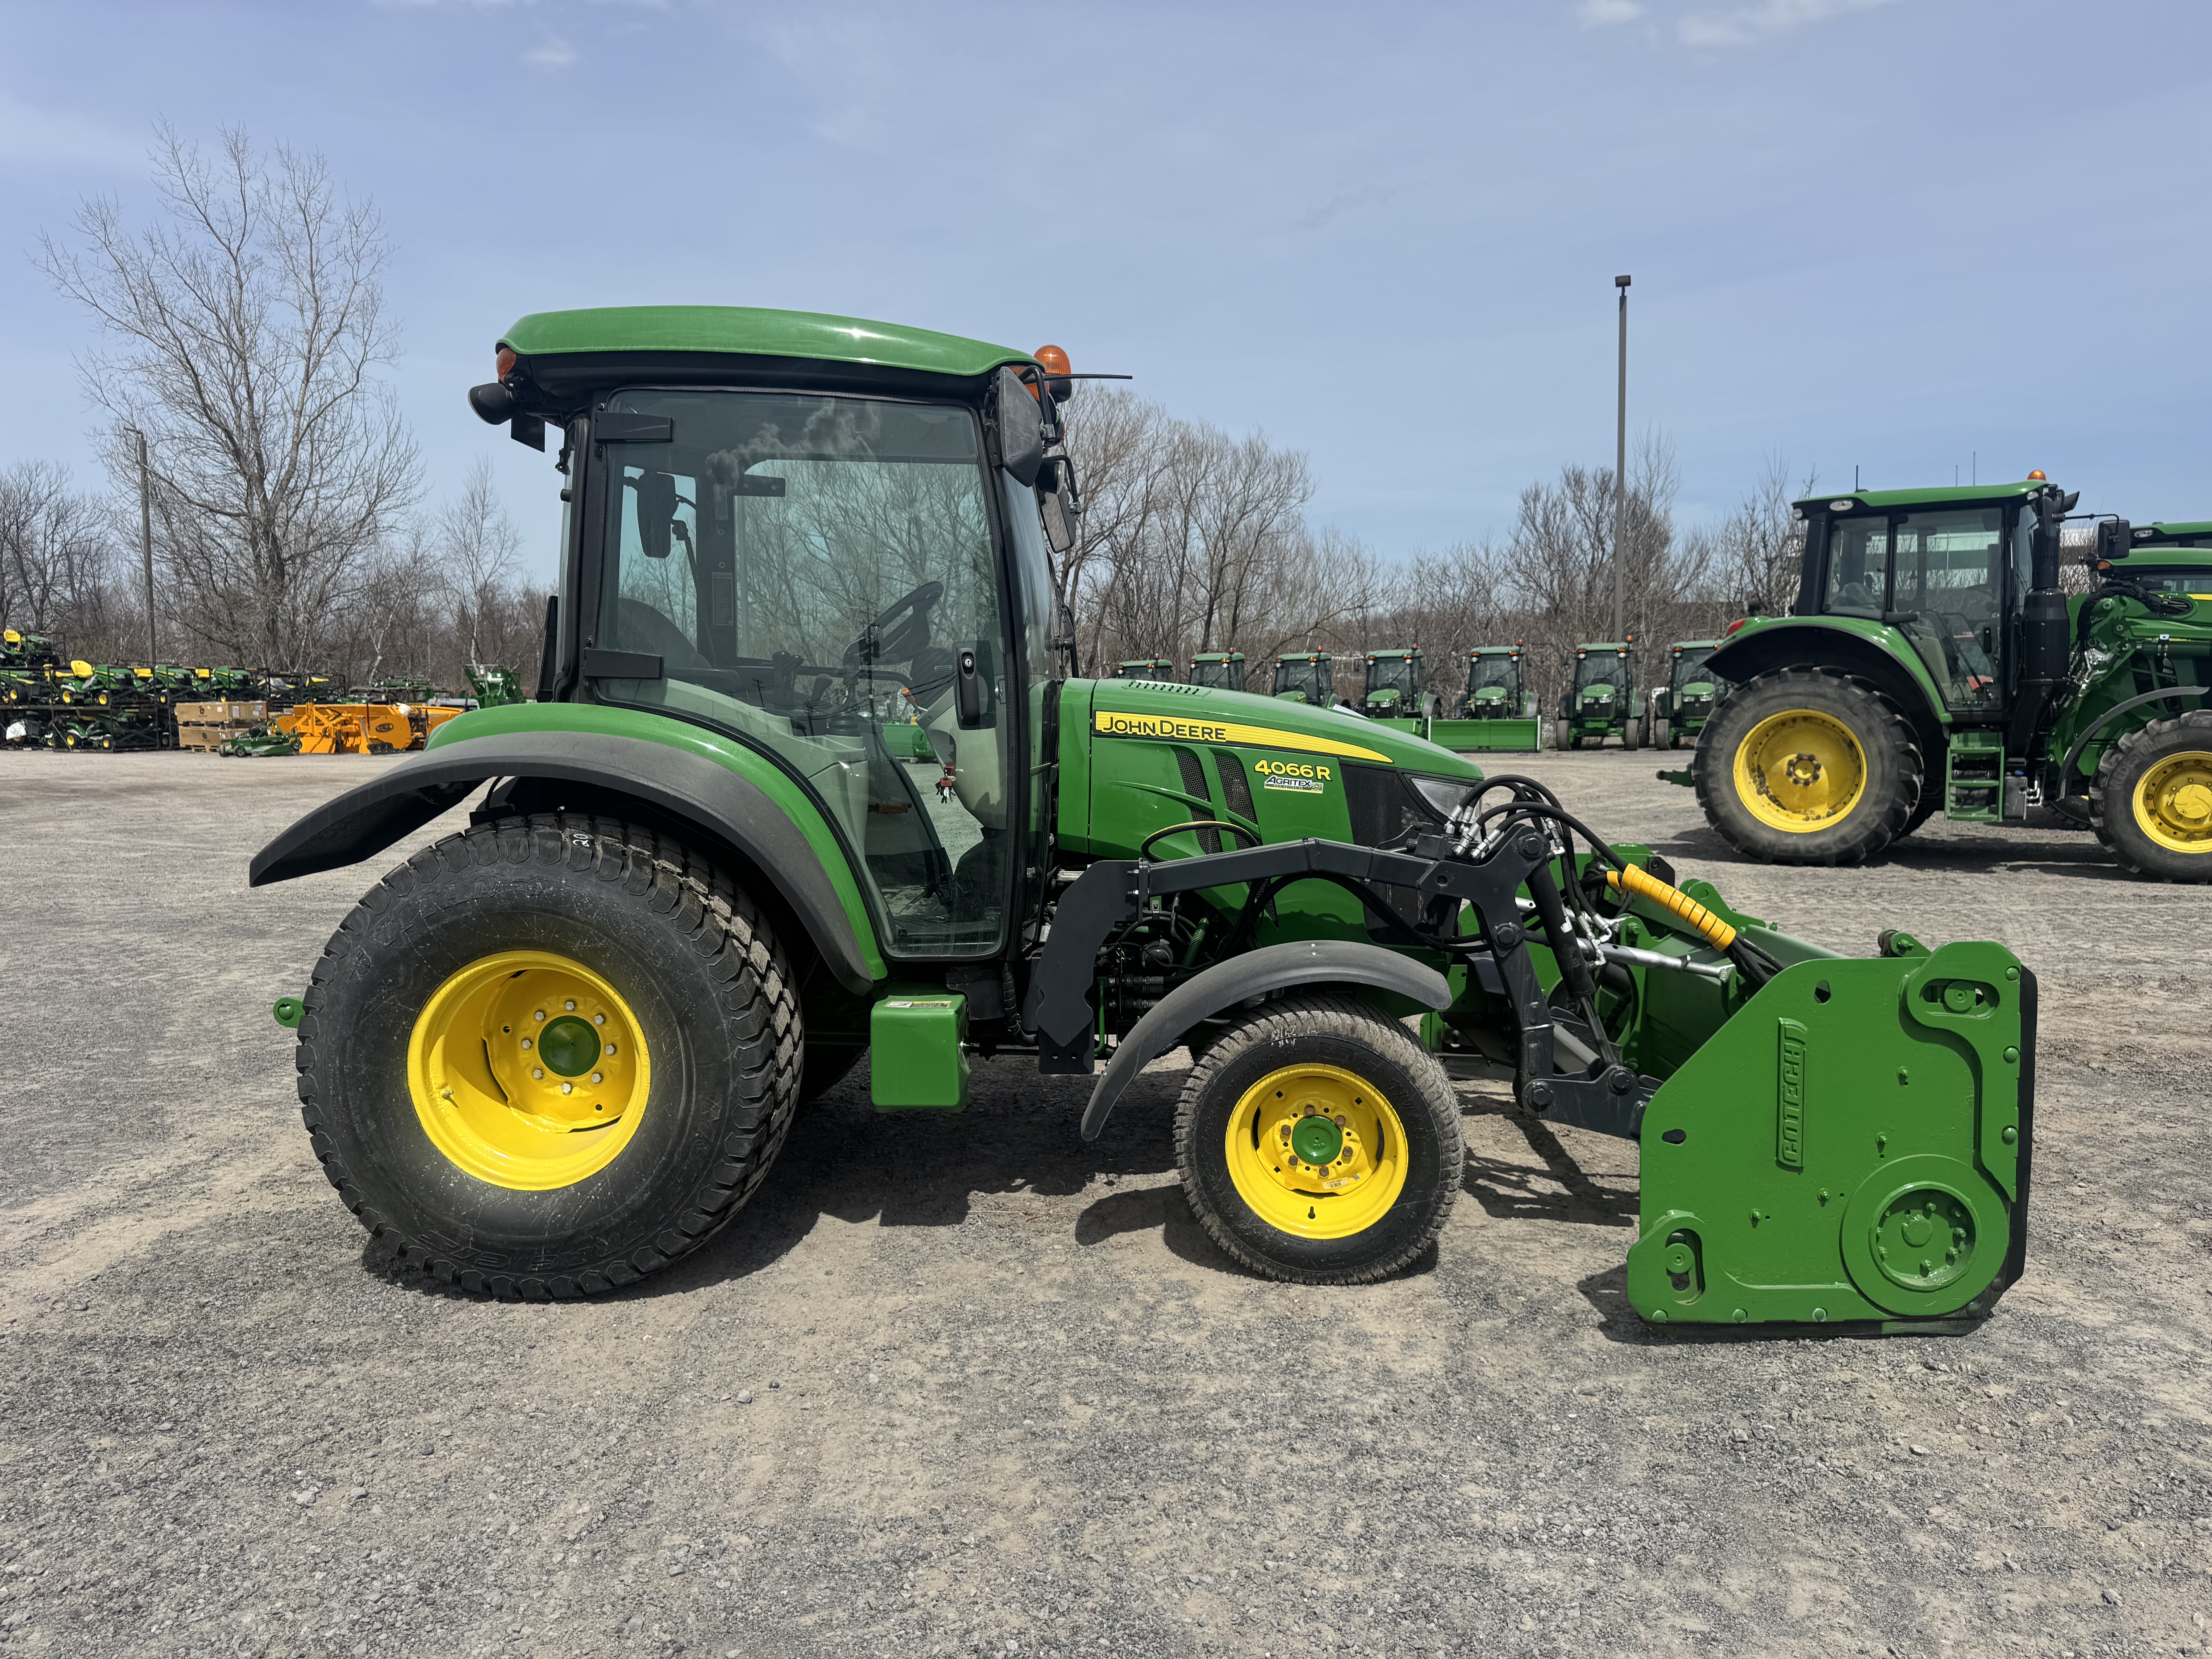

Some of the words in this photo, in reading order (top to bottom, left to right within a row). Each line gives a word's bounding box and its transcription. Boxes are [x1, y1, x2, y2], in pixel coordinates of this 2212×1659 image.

[1103, 716, 1156, 734] JOHN
[1160, 720, 1226, 740] DEERE
[1266, 776, 1311, 787] AGRITEX
[572, 834, 590, 847] 20
